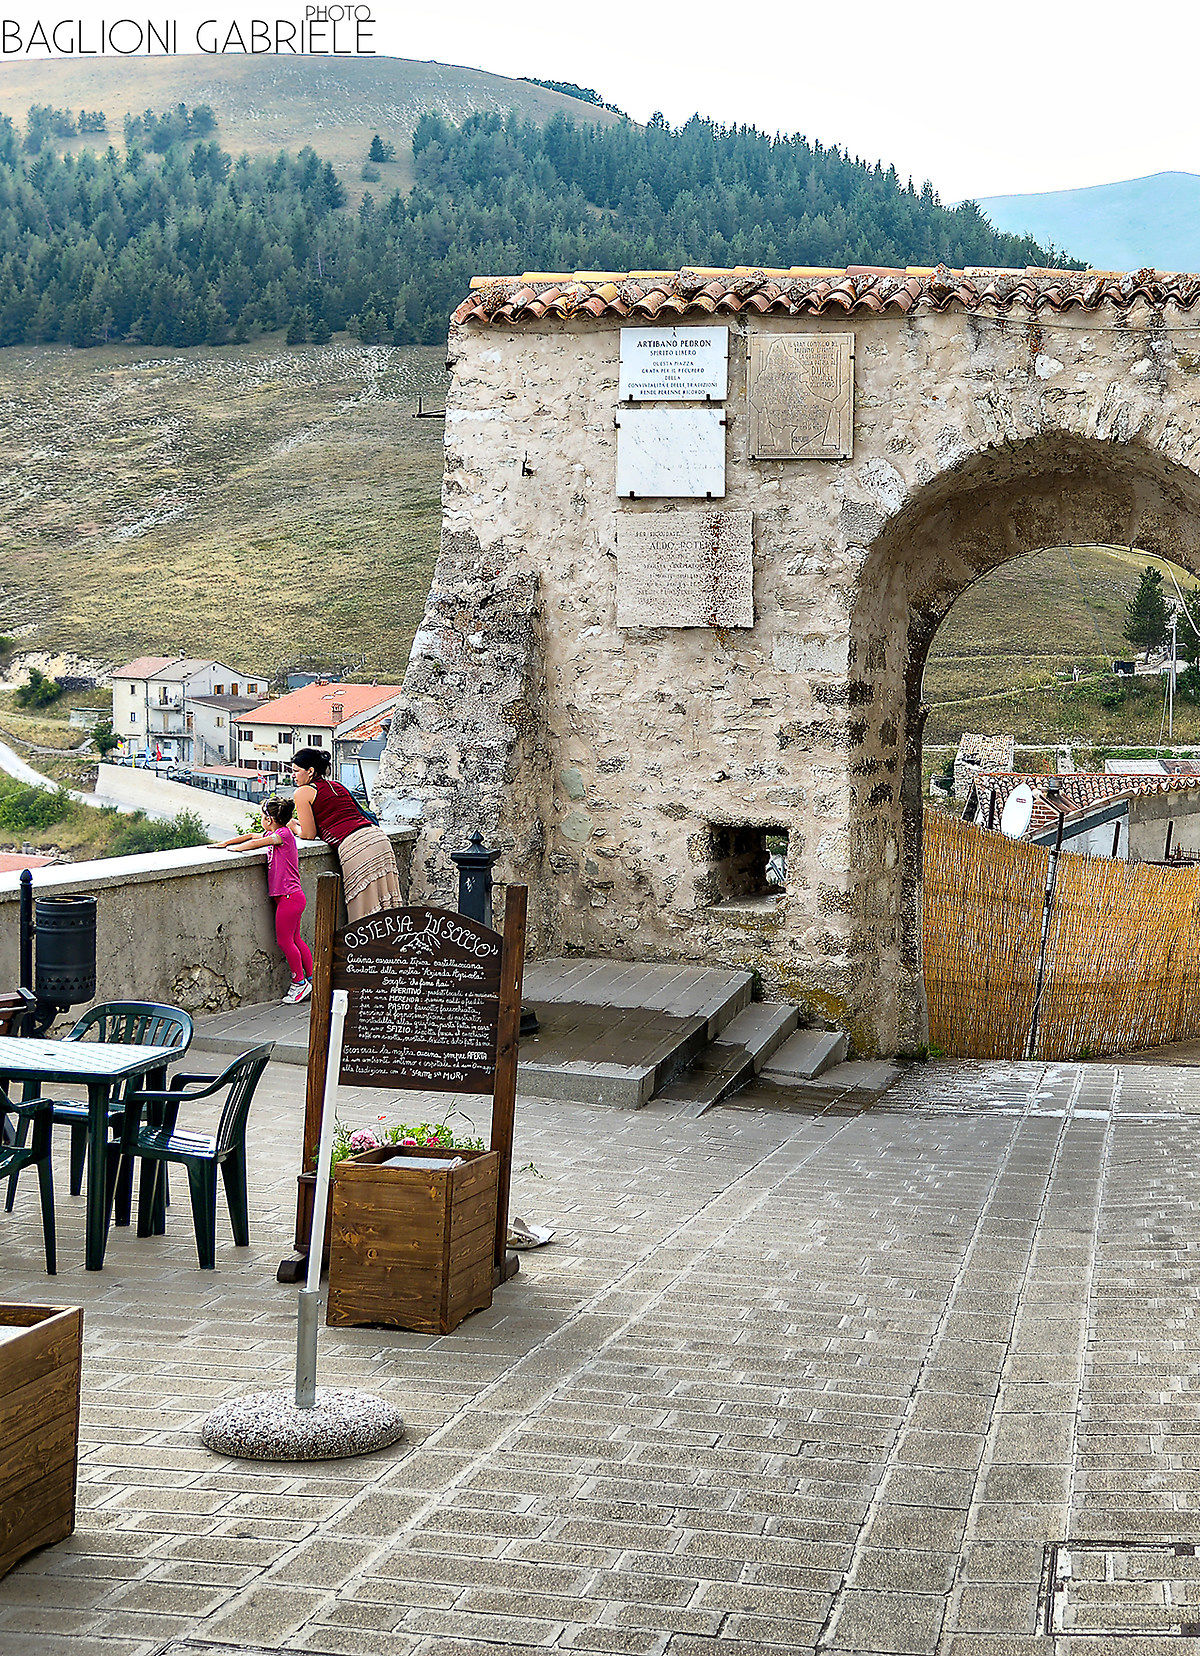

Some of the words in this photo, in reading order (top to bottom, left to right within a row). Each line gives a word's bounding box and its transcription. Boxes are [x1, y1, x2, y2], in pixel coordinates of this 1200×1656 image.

[637, 340, 678, 348] ARTIBANO
[680, 339, 712, 347] PEDRON
[344, 915, 413, 948] OSTERIA
[346, 953, 375, 964] Cucina
[409, 956, 431, 967] tipica
[346, 964, 378, 974] Prodotti
[380, 966, 397, 975] della
[398, 966, 421, 976] nostra
[380, 1044, 392, 1055] la
[392, 1046, 416, 1057] nostra
[443, 1052, 467, 1062] sempre
[467, 1050, 488, 1061] APERTA
[392, 1057, 418, 1066] intimo
